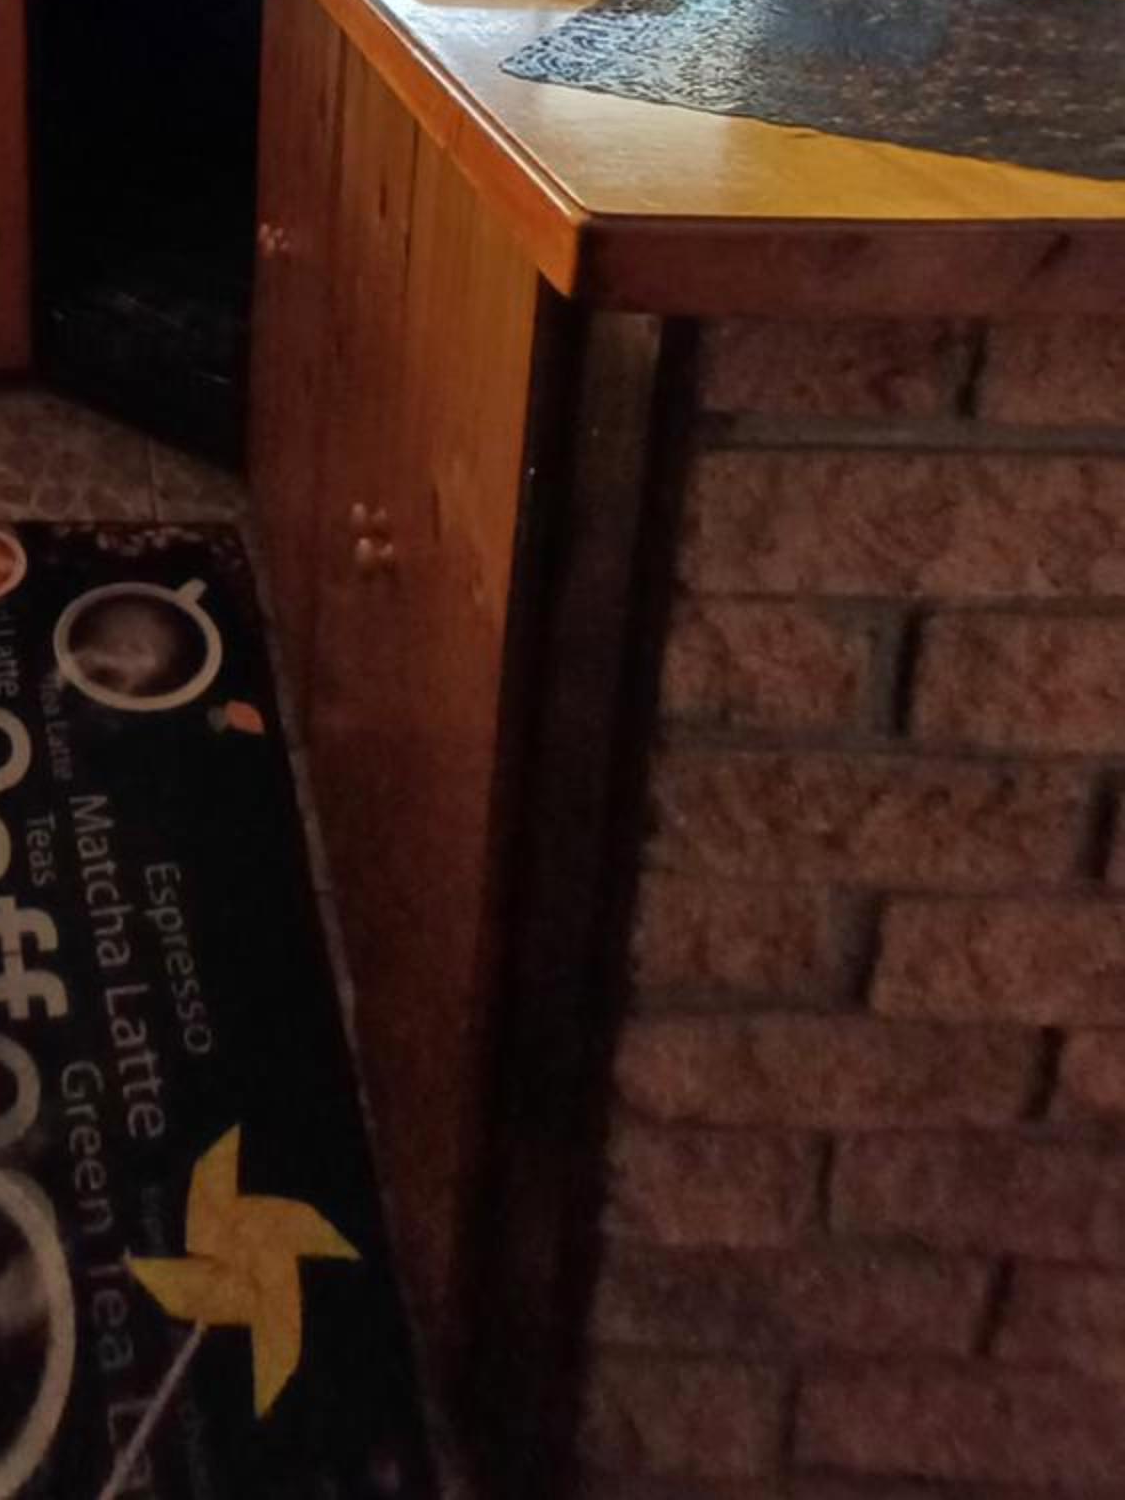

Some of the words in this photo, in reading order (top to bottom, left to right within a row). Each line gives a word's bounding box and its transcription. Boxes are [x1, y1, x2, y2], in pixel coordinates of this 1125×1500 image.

[26, 812, 59, 888] Teas
[70, 794, 137, 968] Matcha
[104, 983, 168, 1141] Latte
[143, 861, 217, 1056] Espresso
[59, 1059, 116, 1235] Green
